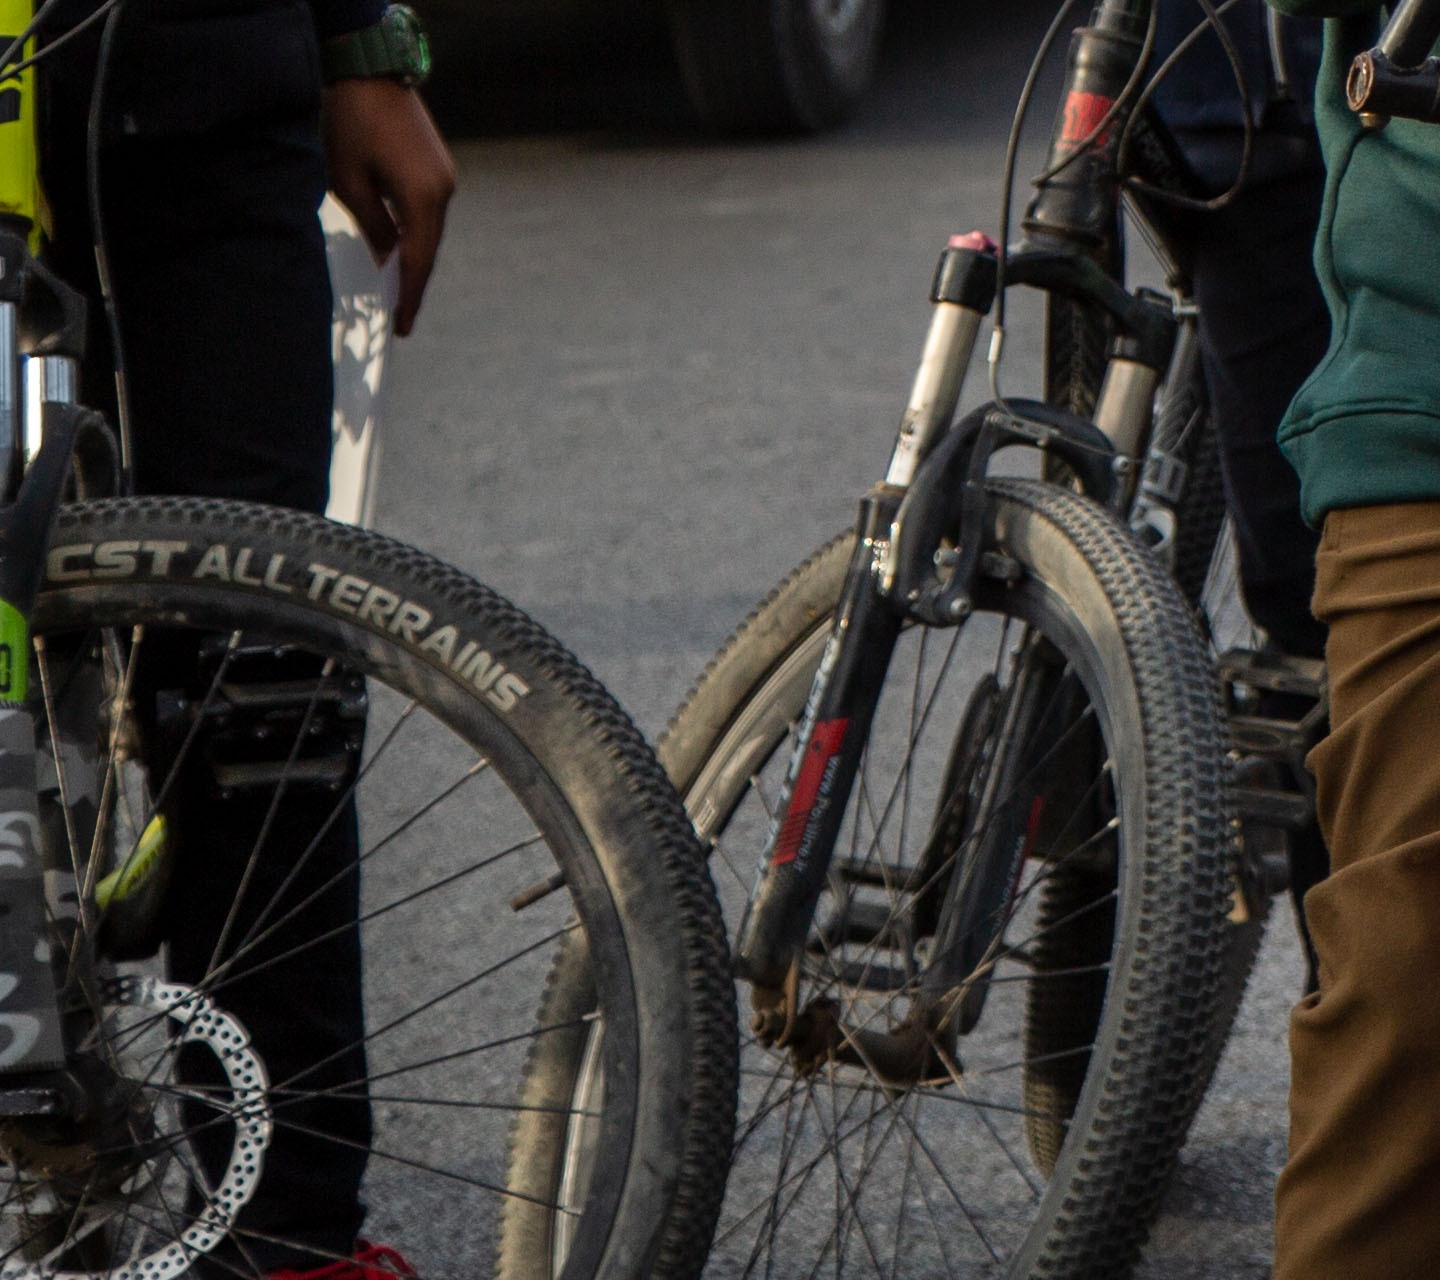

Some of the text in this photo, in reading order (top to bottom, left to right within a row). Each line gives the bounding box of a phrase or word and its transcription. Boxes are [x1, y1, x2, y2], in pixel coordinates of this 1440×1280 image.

[48, 538, 532, 713] CST ALL TERRAINS
